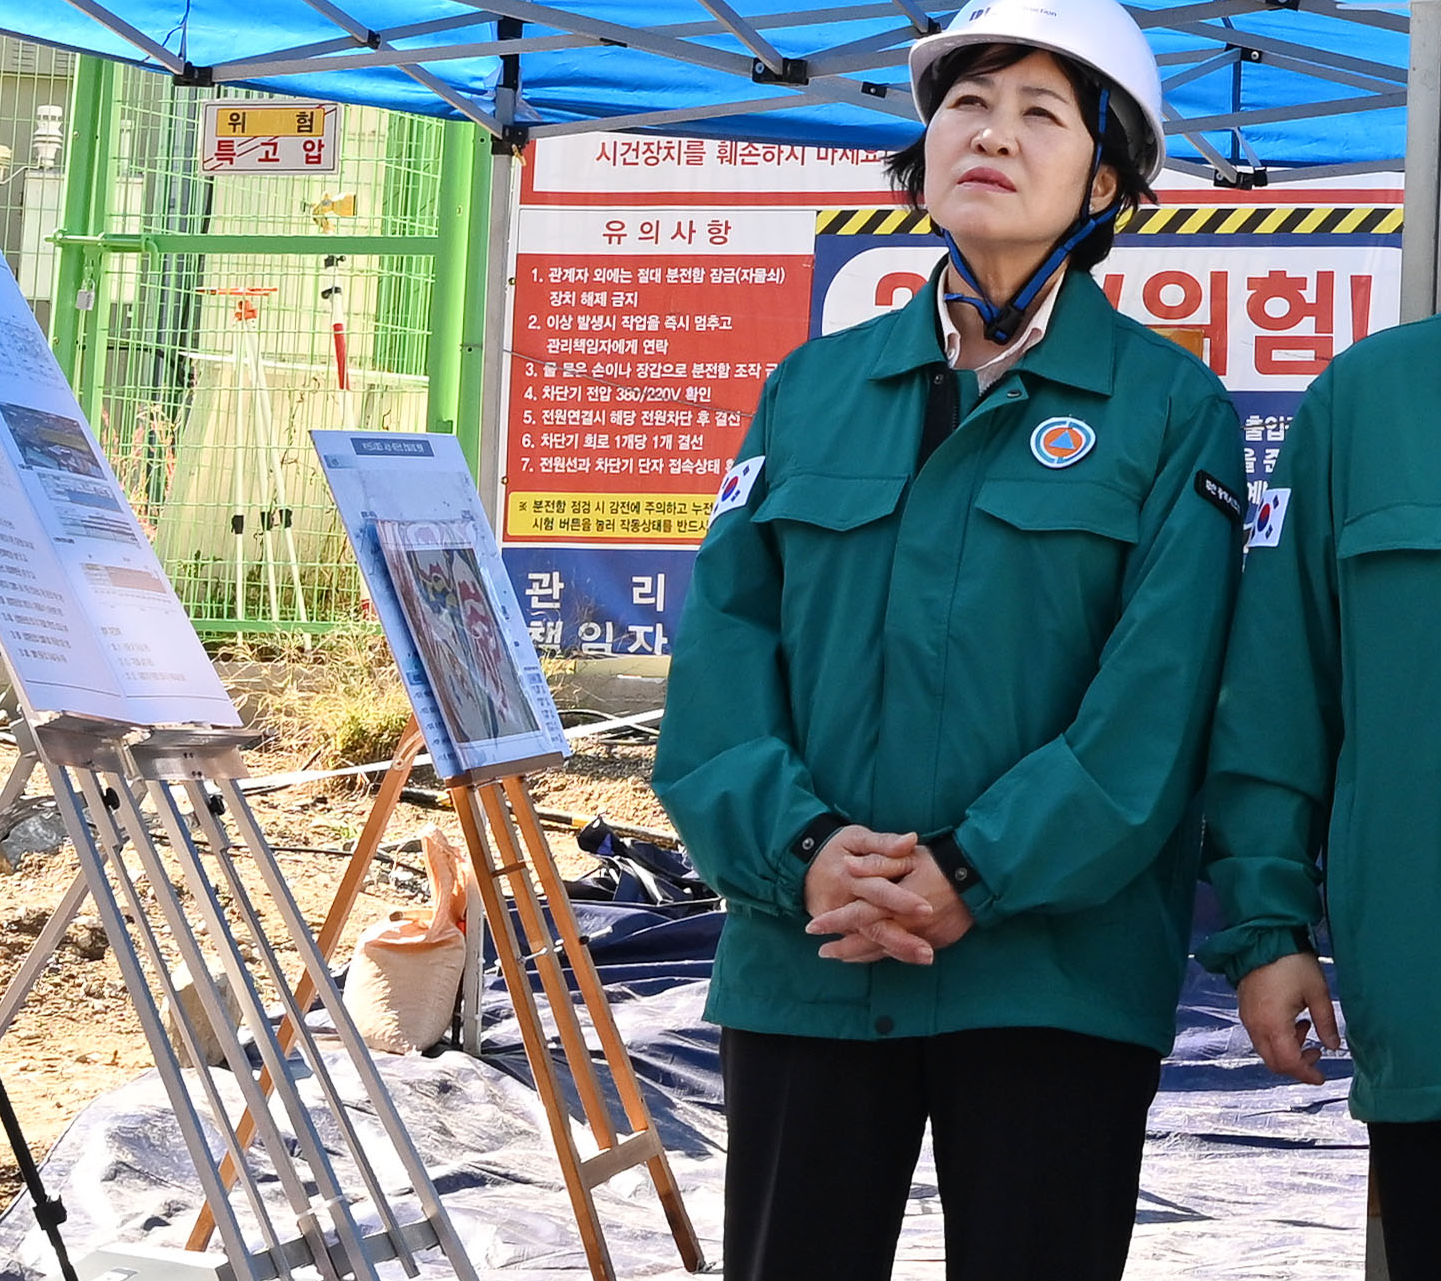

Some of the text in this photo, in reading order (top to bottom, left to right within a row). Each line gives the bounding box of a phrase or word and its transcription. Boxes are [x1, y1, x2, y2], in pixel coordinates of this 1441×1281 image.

[228, 111, 314, 134] 위험
[215, 139, 325, 165] 특고압
[595, 140, 707, 167] 시건장치를
[717, 141, 806, 167] 훼손하지
[532, 267, 785, 286] 1. 관계자 외에는 절대 분전함 잠금(자물쇠)
[550, 291, 638, 308] 장치 해제 금지
[528, 315, 732, 331] 2. 이상 발생시 작업을 즉시 멈추고
[547, 338, 668, 355] 관리책임자에게 연락
[526, 364, 537, 376] 3.
[592, 363, 632, 378] 손이나
[636, 363, 687, 378] 장갑으로
[691, 363, 730, 379] 분전함
[734, 363, 761, 378] 조작
[524, 386, 711, 402] 4. 차단기 전압 380/220V 확인
[523, 410, 740, 427] 5. 전원연결시 해당 전원차단 후 결선
[522, 434, 704, 450] 6. 차단기 회로 1개당 1개 결선
[521, 459, 534, 472] 7.
[540, 458, 591, 474] 전원선과
[596, 458, 634, 474] 차단기
[638, 458, 664, 474] 단자
[669, 458, 720, 475] 접속상태
[533, 500, 566, 514] 분전함
[571, 501, 591, 514] 점검
[595, 501, 605, 514] 시
[610, 501, 641, 515] 감전에
[645, 501, 687, 516] 주의하고
[532, 517, 554, 531] 시험
[559, 518, 591, 531] 버튼을
[620, 519, 672, 533] 작동상태를
